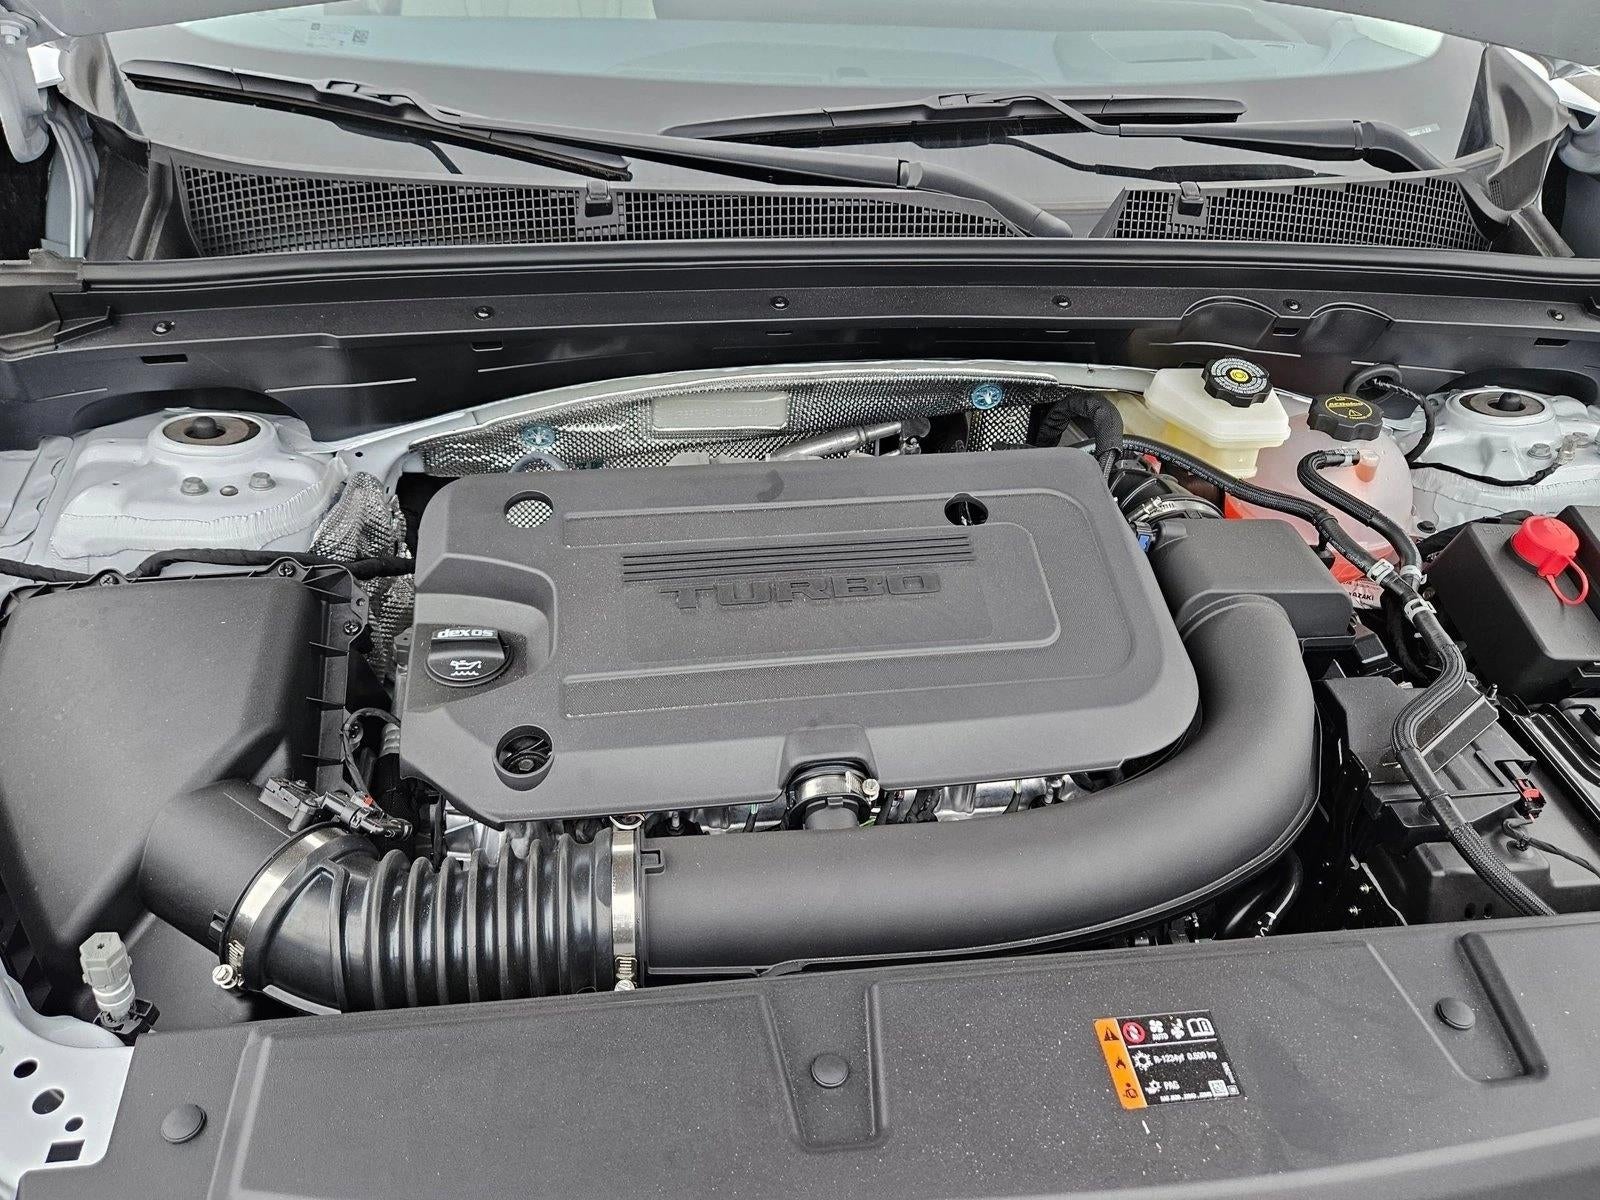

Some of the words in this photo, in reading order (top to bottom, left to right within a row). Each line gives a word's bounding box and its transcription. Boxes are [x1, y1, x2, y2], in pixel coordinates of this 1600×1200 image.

[659, 571, 941, 609] TURBO
[437, 628, 494, 638] dexos
[1163, 1080, 1181, 1091] PAG
